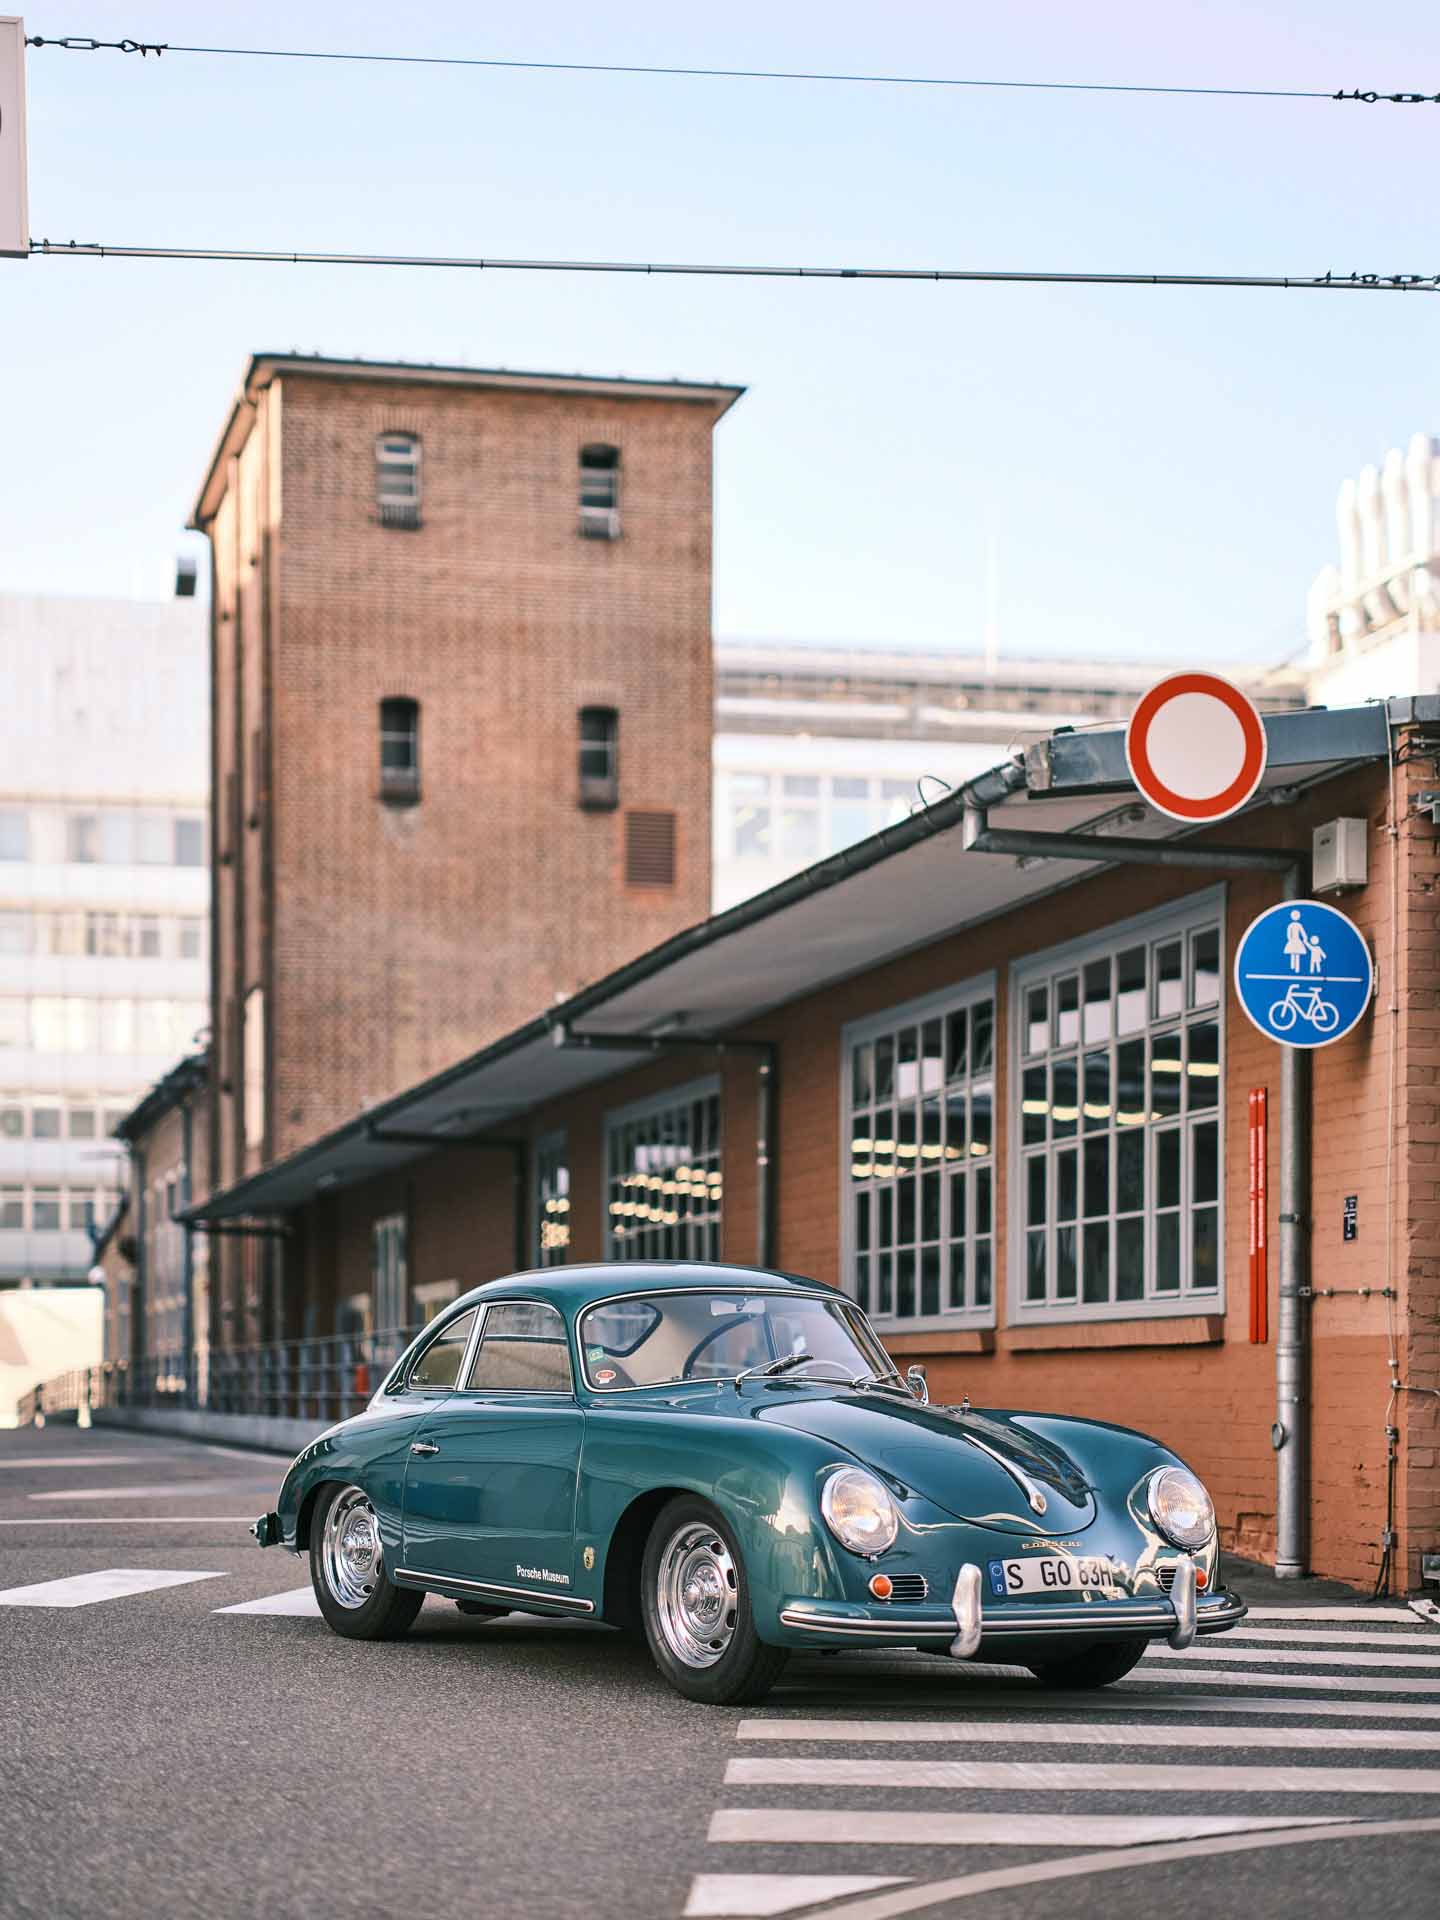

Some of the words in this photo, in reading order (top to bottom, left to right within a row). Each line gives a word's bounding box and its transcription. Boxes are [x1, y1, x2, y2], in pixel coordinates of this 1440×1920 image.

[516, 1565, 542, 1580] Porsche
[542, 1569, 570, 1584] Museum
[1007, 1564, 1023, 1589] S
[1040, 1560, 1071, 1586] GO
[997, 1584, 1003, 1592] D
